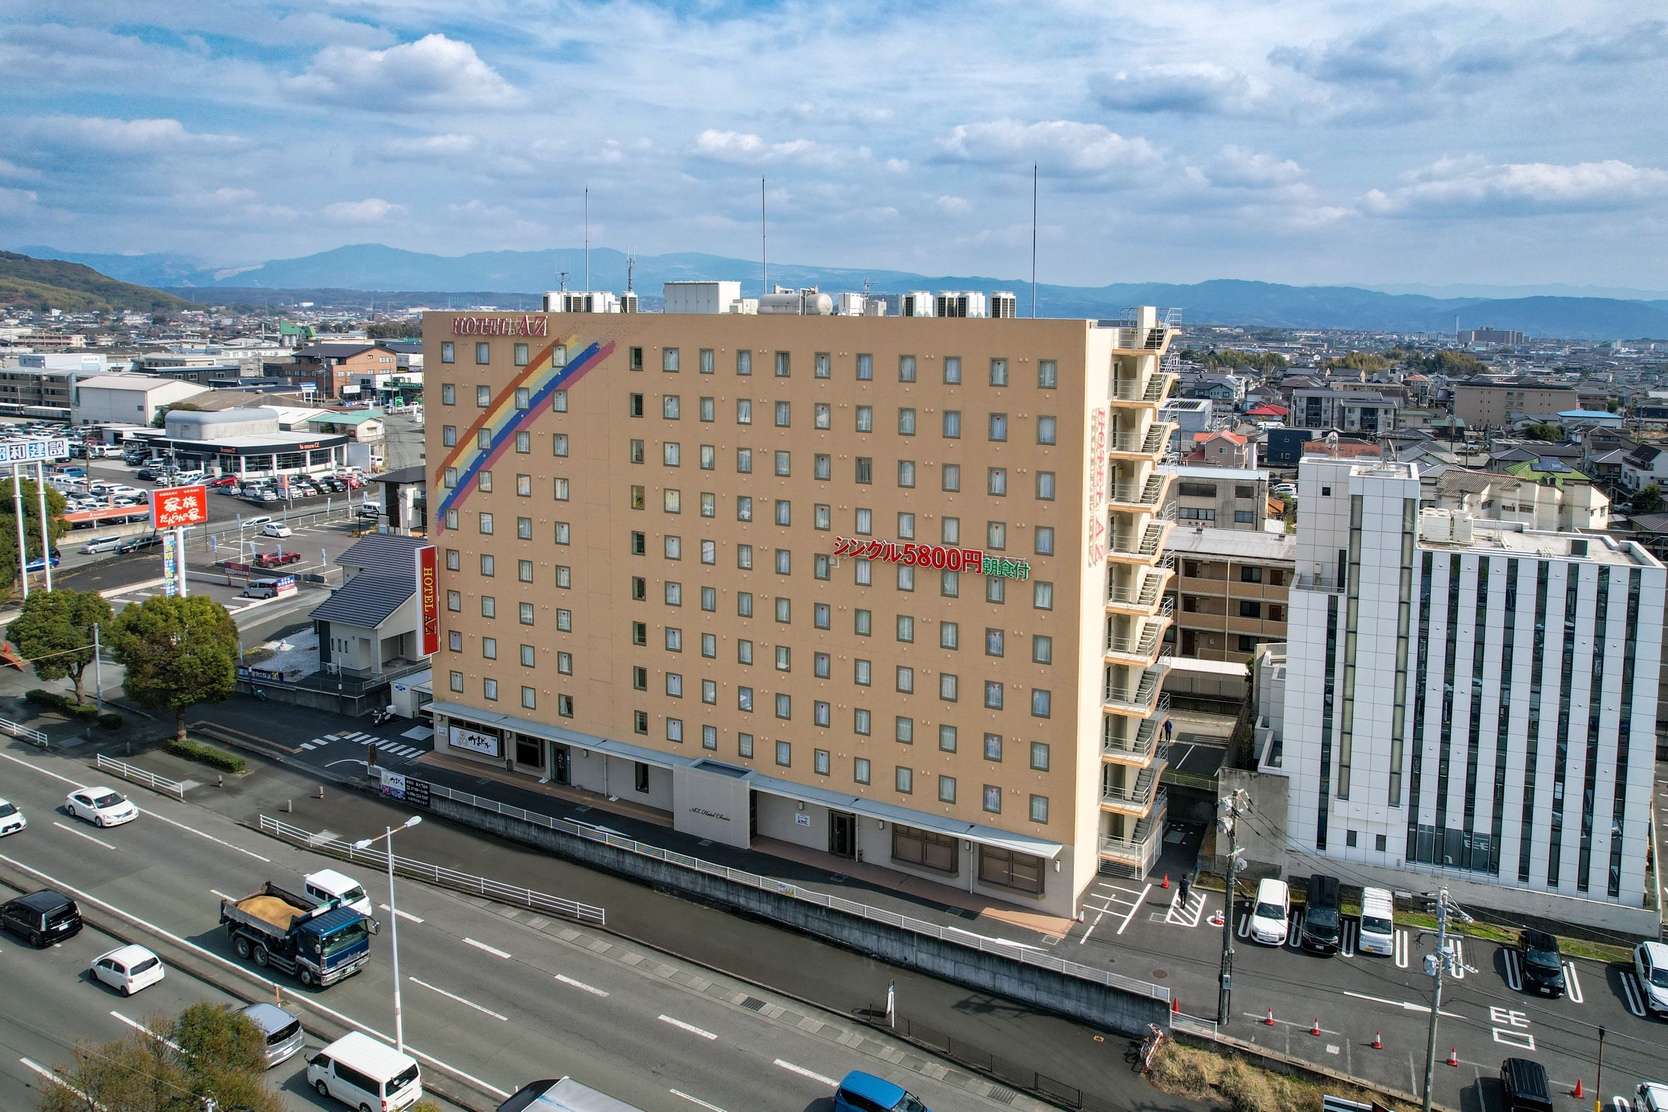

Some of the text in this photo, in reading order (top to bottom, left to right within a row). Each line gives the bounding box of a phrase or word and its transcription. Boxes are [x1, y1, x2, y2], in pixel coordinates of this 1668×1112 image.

[451, 315, 549, 337] HOTEL AZ
[163, 496, 198, 512] 家族
[160, 508, 201, 525] だんらんの家
[423, 567, 437, 635] HOTEL AZ
